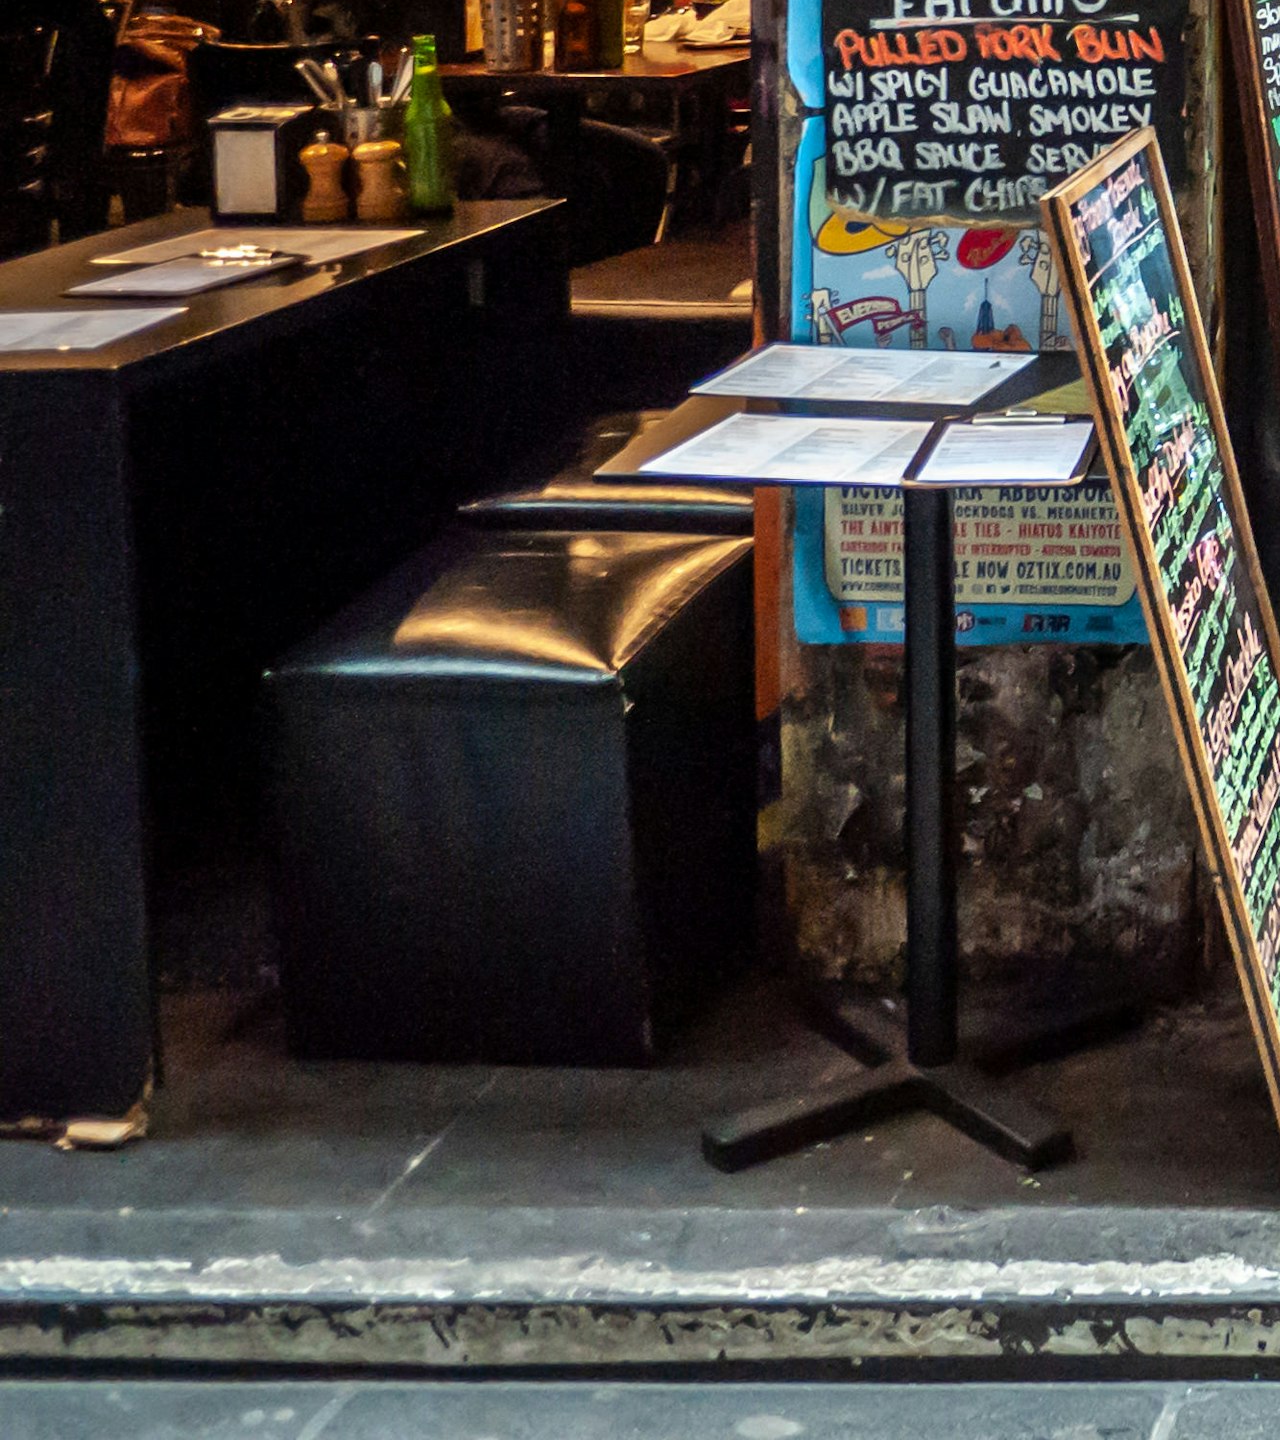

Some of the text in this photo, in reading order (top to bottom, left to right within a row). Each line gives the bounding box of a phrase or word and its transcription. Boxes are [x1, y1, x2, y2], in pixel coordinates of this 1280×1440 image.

[835, 24, 1164, 70] PULLED PORK BUN
[871, 67, 1156, 102] SPICY GUACAMOLE
[832, 102, 919, 136] APPLE
[1029, 103, 1152, 136] SMOKEY
[833, 138, 1005, 176] BBQ SAUCE
[892, 180, 959, 211] FAT
[977, 561, 1008, 579] NOW
[1017, 562, 1121, 581] OZTIX.COM.AU
